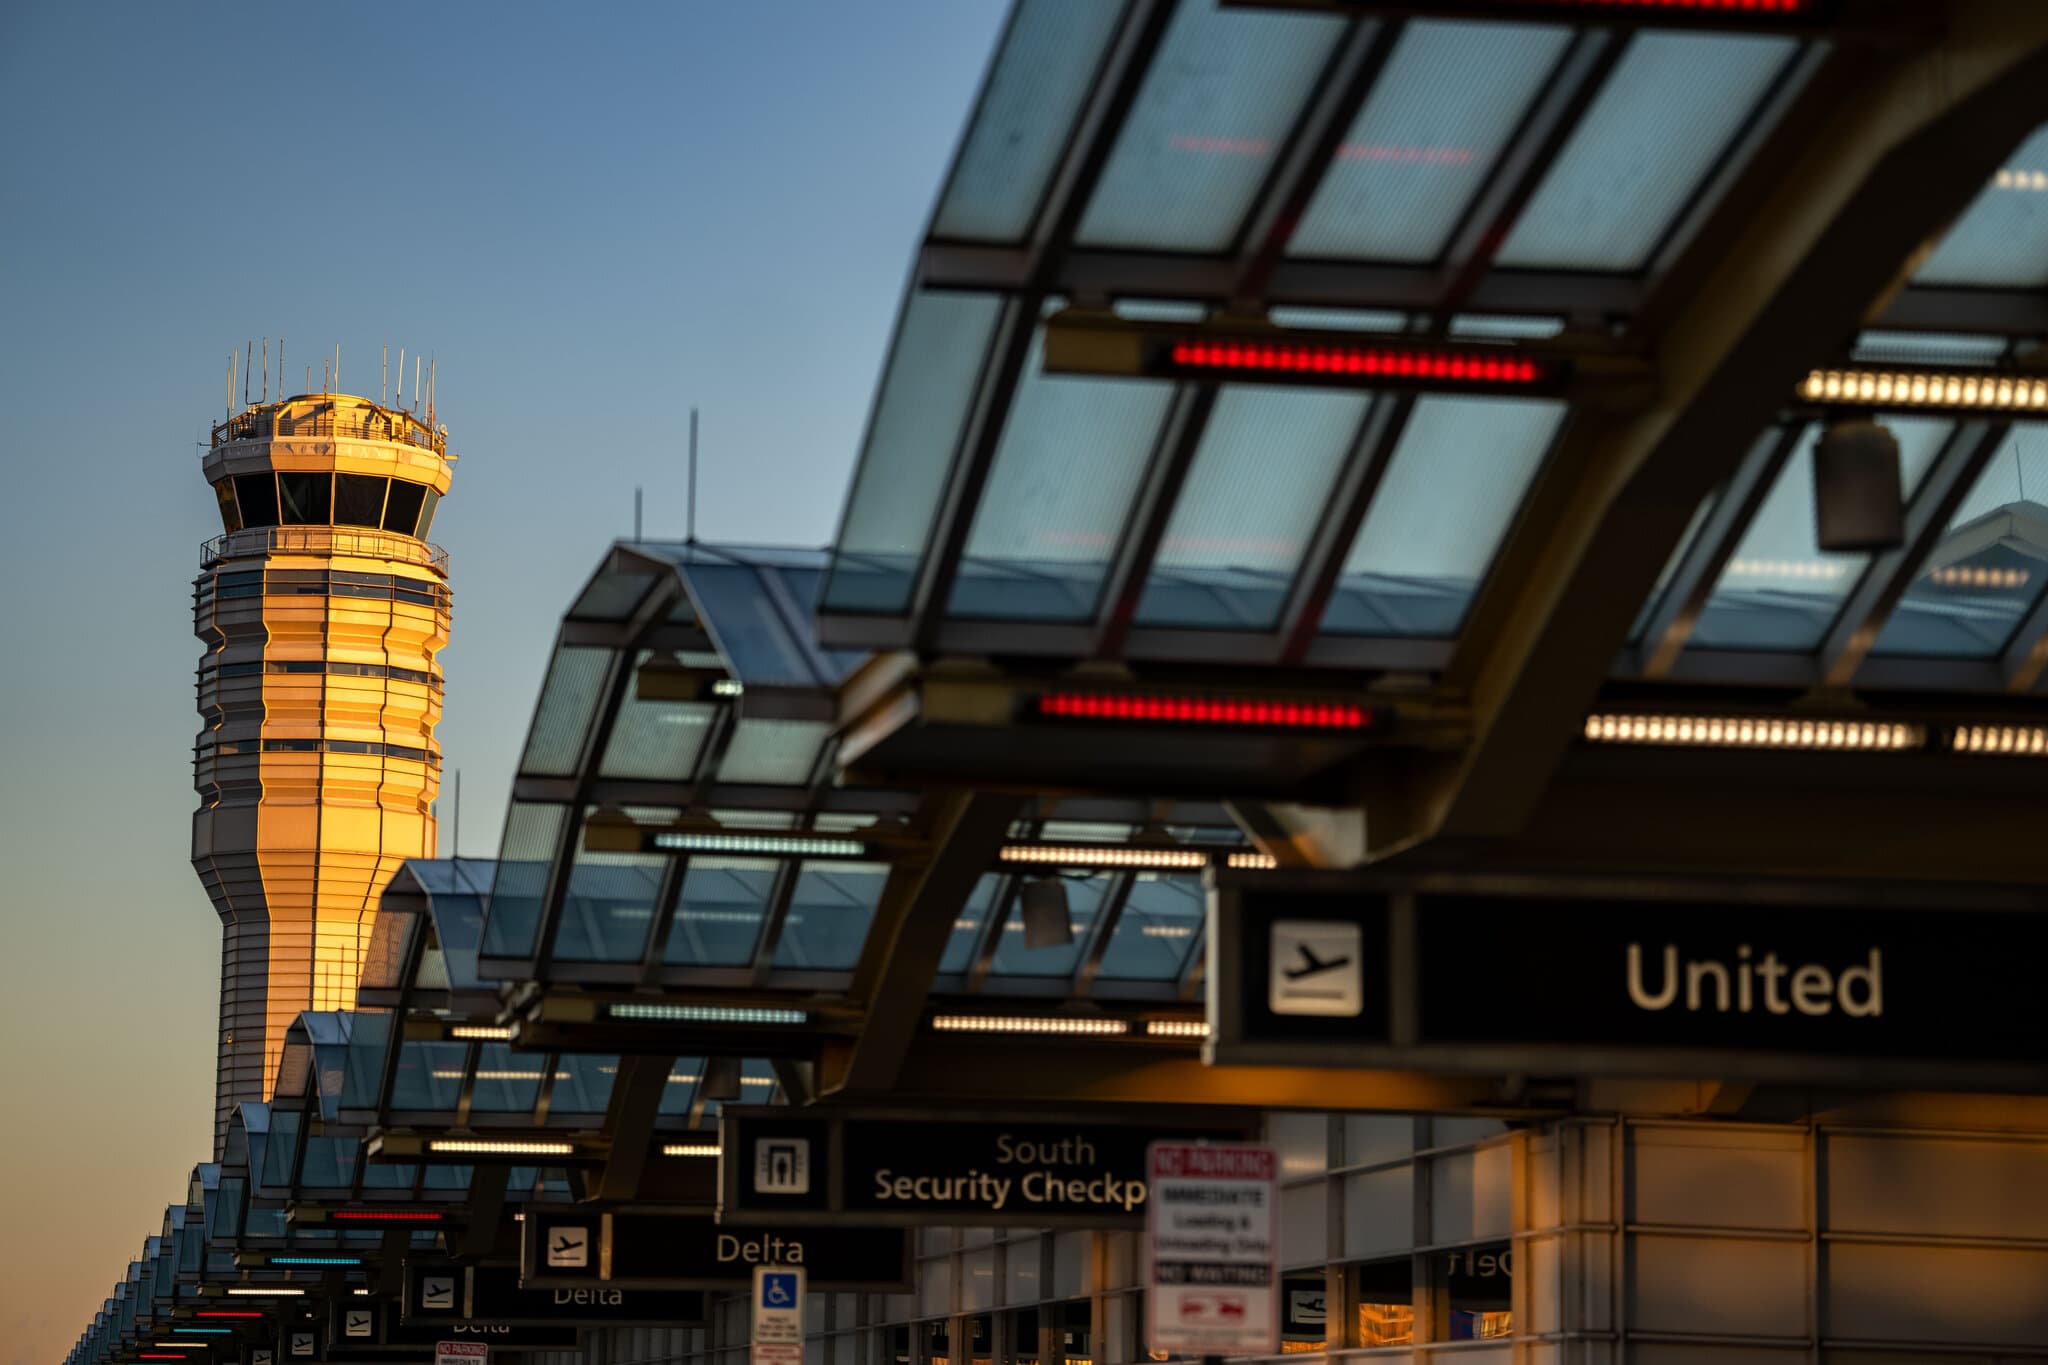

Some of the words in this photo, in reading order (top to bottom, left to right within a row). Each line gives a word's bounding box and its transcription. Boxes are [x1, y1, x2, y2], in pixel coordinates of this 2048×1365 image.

[1624, 941, 1884, 1018] United
[995, 1133, 1096, 1166] South
[874, 1168, 1011, 1210] Security
[1021, 1170, 1149, 1211] Checkp
[716, 1233, 804, 1263] Delta
[554, 1288, 623, 1305] Delta
